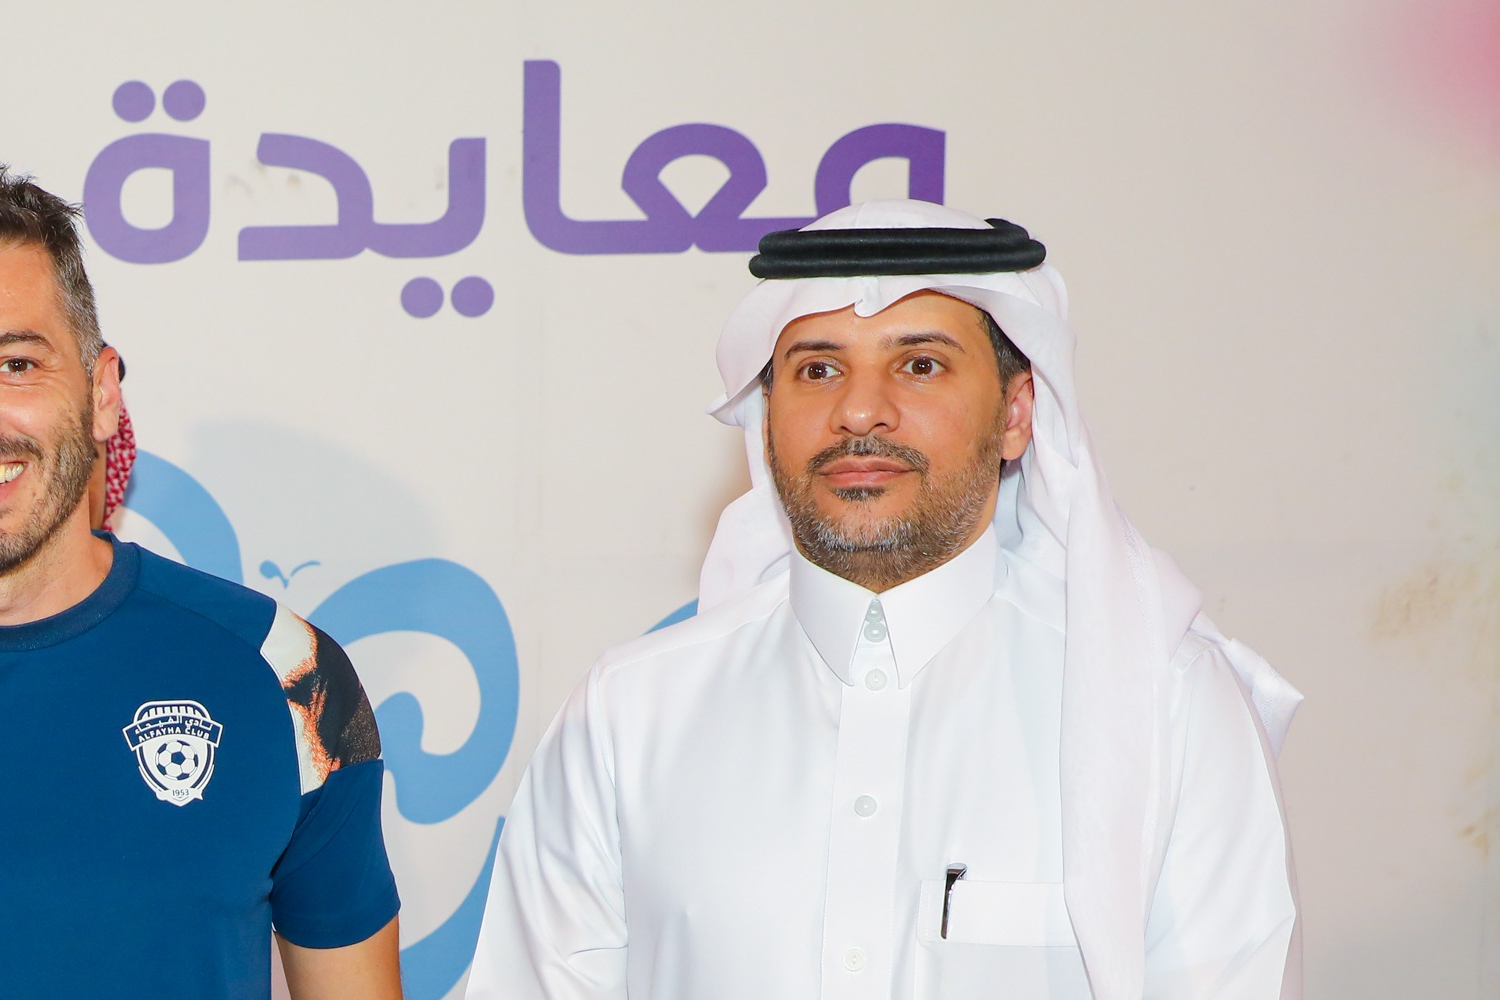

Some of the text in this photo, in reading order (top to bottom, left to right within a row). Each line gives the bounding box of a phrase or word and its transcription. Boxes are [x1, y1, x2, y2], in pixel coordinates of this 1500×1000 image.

[83, 59, 947, 320] معايدة
[138, 727, 210, 743] ALFAYHA CLUB
[172, 789, 190, 797] 1953
